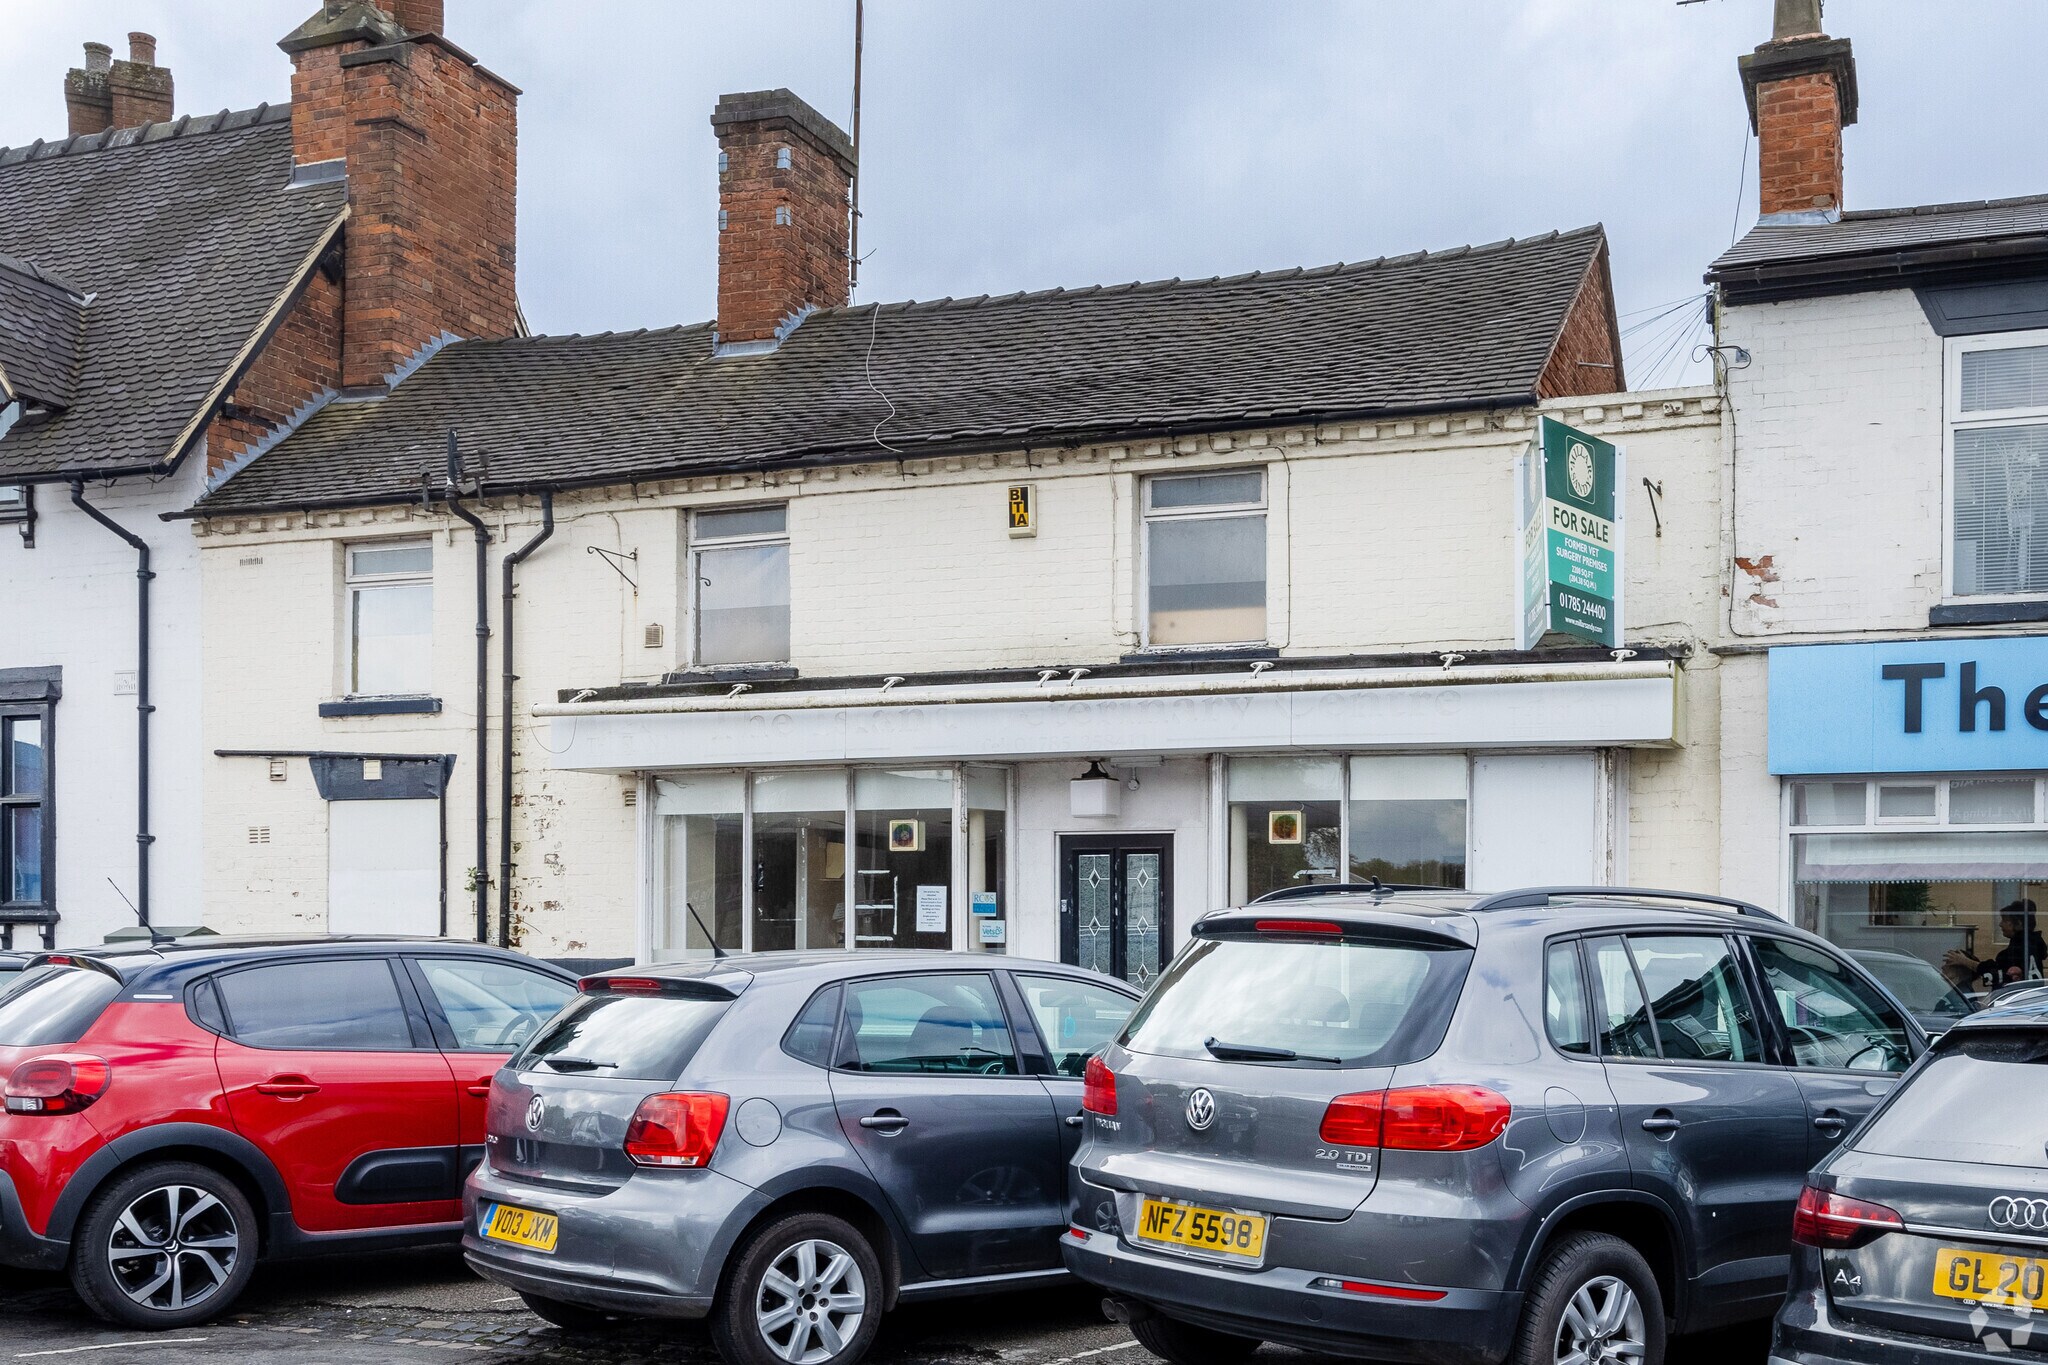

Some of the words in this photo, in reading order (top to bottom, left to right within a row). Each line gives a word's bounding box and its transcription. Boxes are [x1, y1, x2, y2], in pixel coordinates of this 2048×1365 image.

[1553, 506, 1578, 532] FOR
[1580, 516, 1609, 543] SALE
[1556, 546, 1582, 564] SURGERY
[1582, 555, 1608, 573] PREMISES
[1564, 537, 1588, 553] FORMER
[1588, 545, 1600, 558] VET
[1559, 592, 1581, 613] 01785
[1581, 599, 1606, 621] 244400
[1564, 616, 1603, 633] www.millarsandy.com
[1315, 1148, 1340, 1161] 2.0
[522, 1216, 556, 1243] JXM
[1146, 1205, 1187, 1237] NFZ
[1190, 1212, 1253, 1248] 5598
[1833, 1268, 1862, 1287] A4
[1949, 1256, 2045, 1301] GL20
